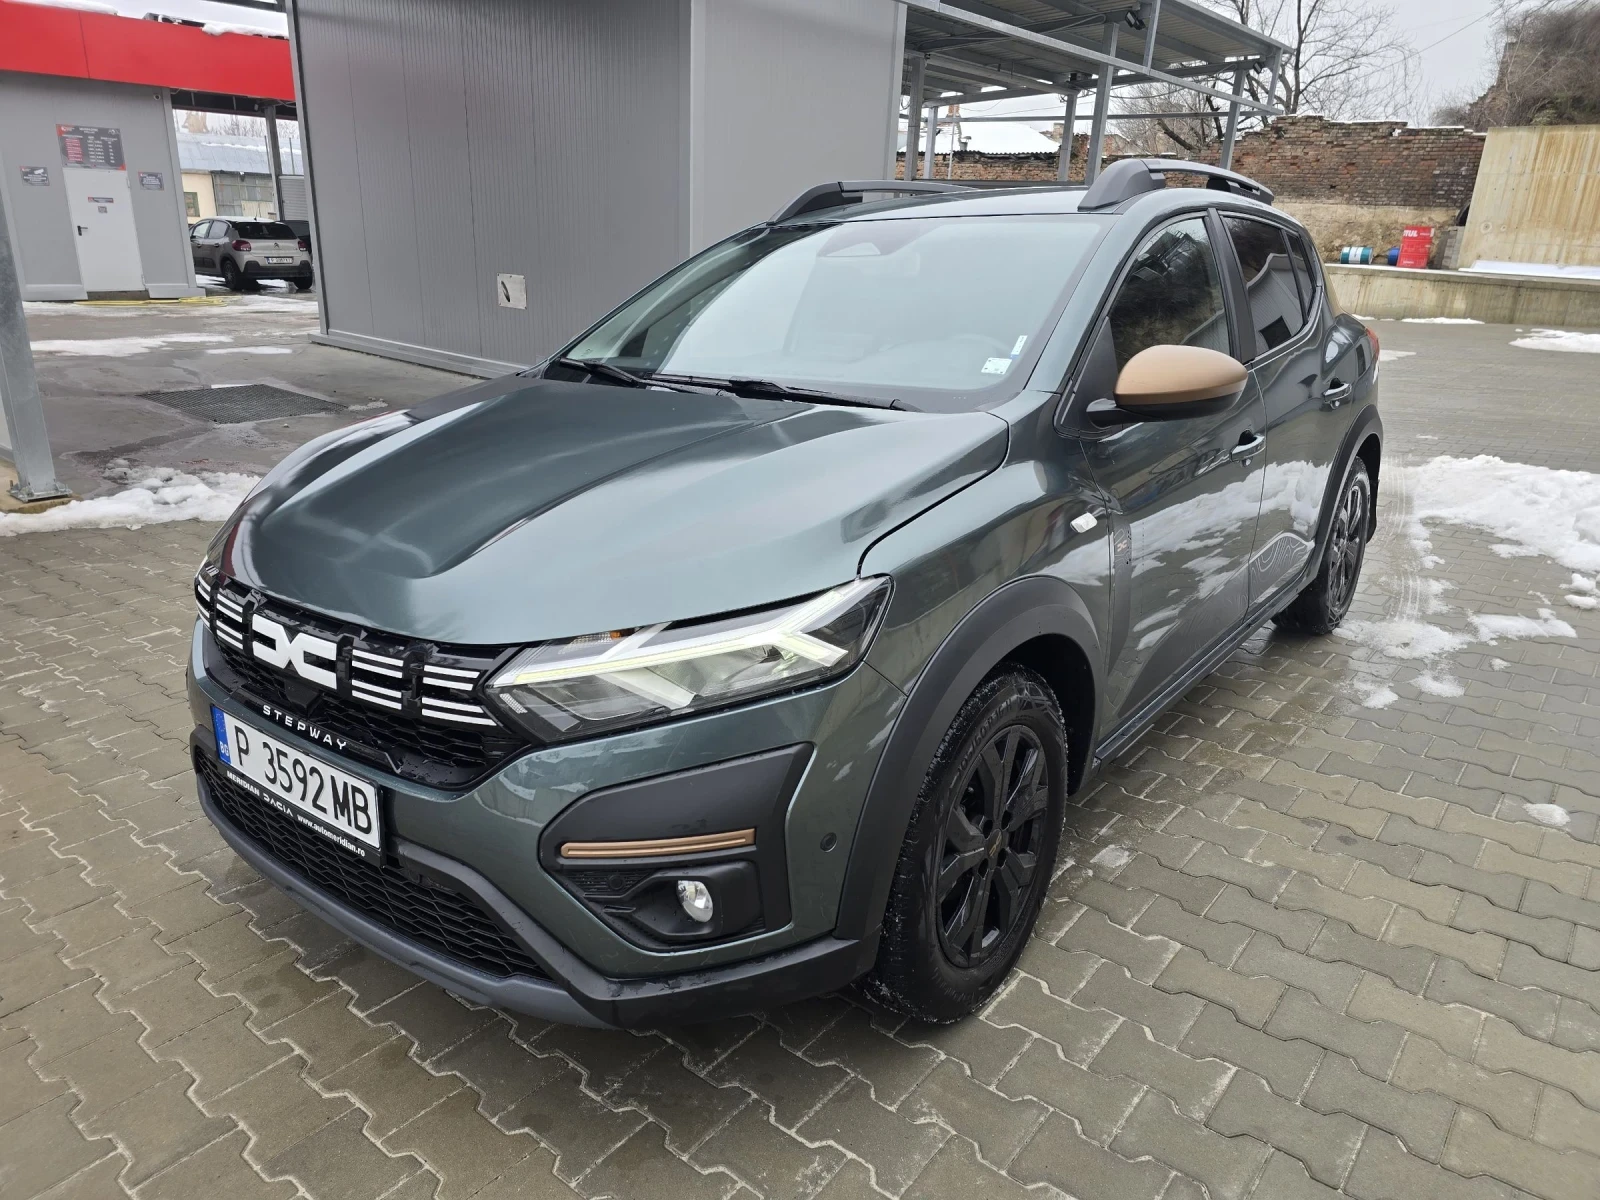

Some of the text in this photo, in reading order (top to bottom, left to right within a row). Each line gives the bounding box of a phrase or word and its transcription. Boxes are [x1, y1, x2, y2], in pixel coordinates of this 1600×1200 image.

[219, 740, 230, 757] BG
[234, 724, 250, 766] P
[262, 704, 347, 750] STEPWAY
[226, 770, 366, 857] MERIDIAN DACIA www.automeridian.ro
